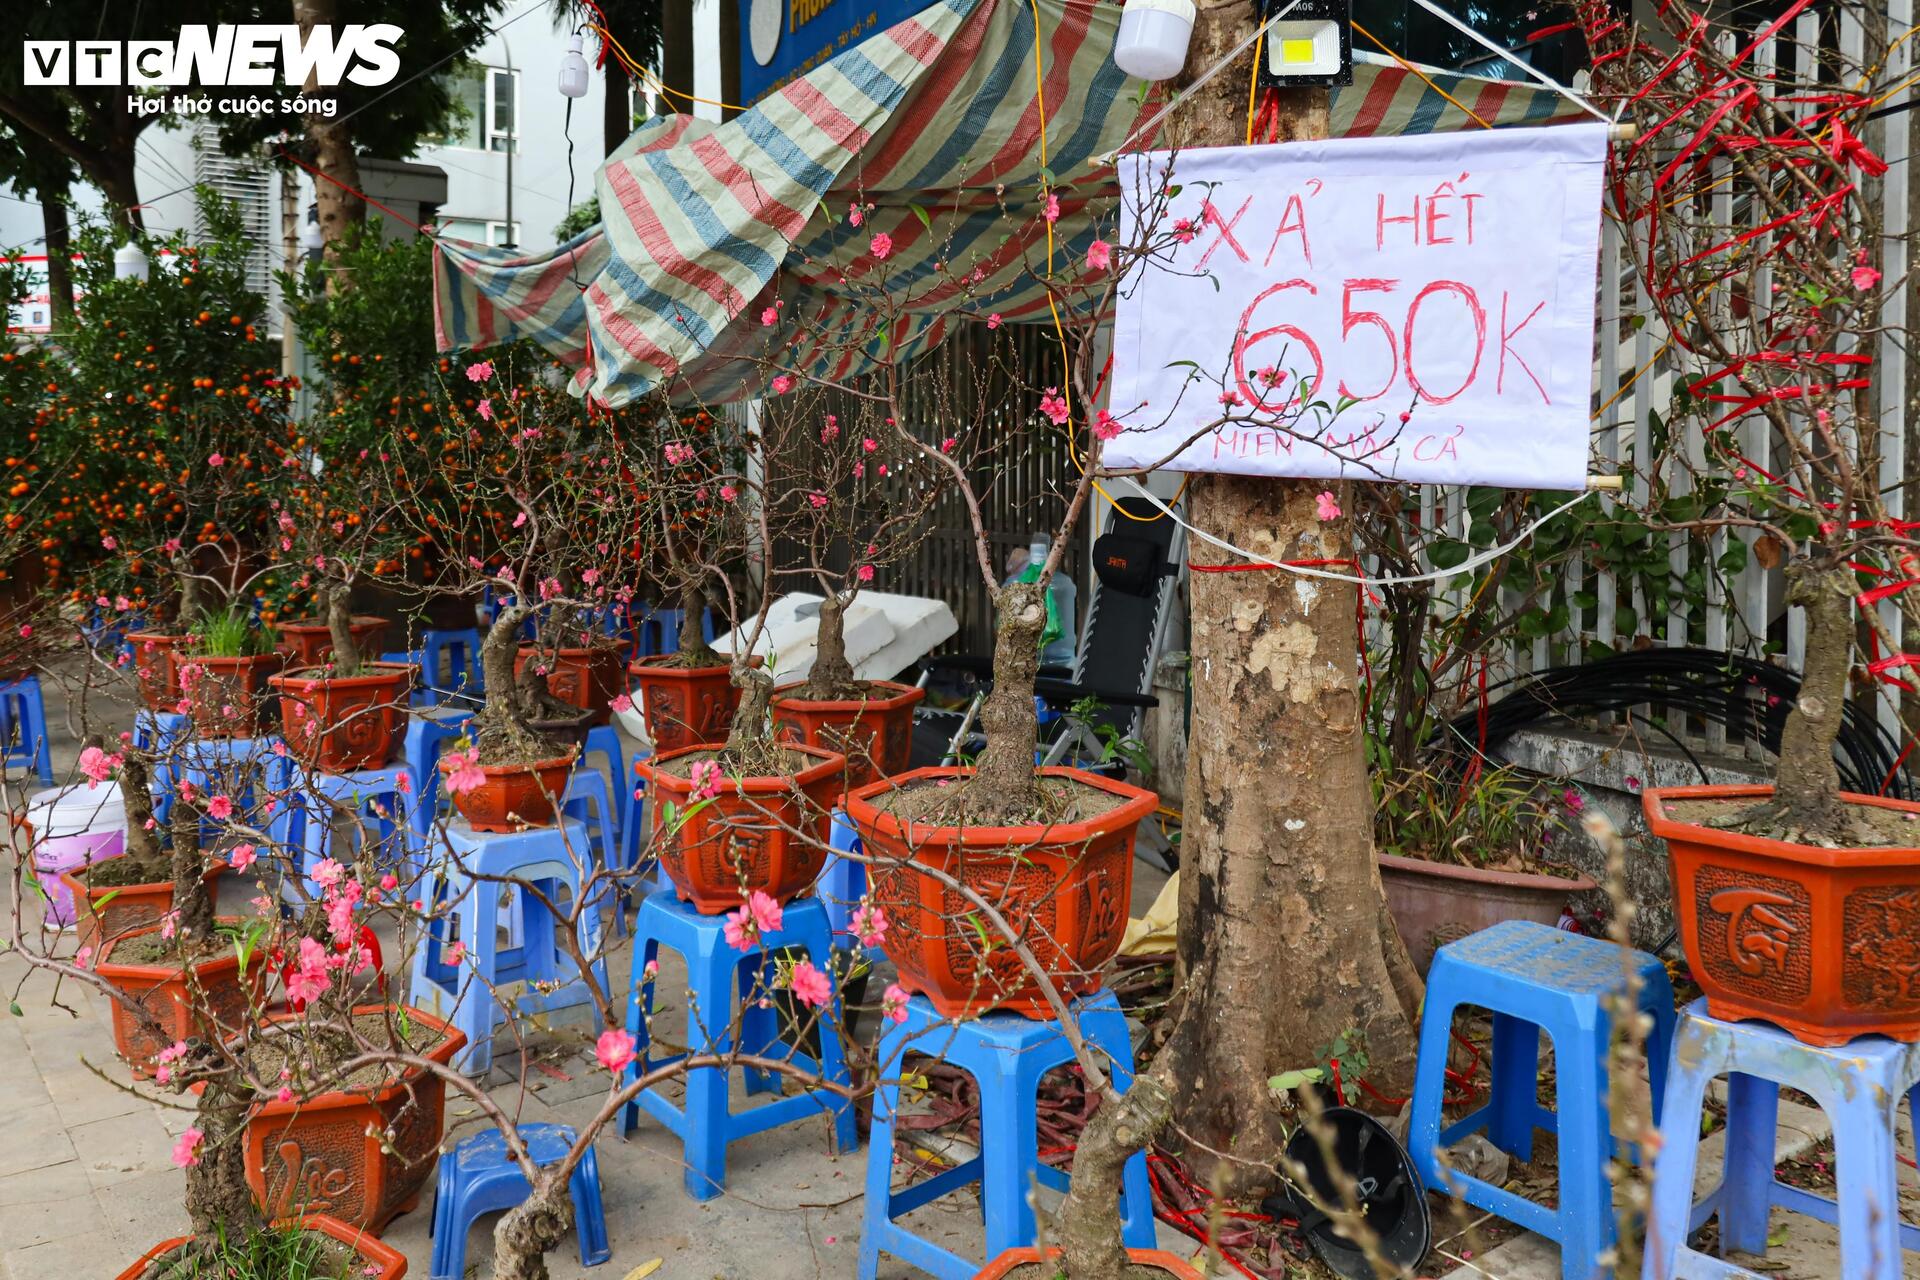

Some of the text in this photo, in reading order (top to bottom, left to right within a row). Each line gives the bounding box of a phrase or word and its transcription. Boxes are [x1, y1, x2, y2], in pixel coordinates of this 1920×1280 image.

[1193, 170, 1486, 272] XẢ HẾT
[1233, 278, 1552, 414] 650K
[1413, 425, 1465, 461] CẢ
